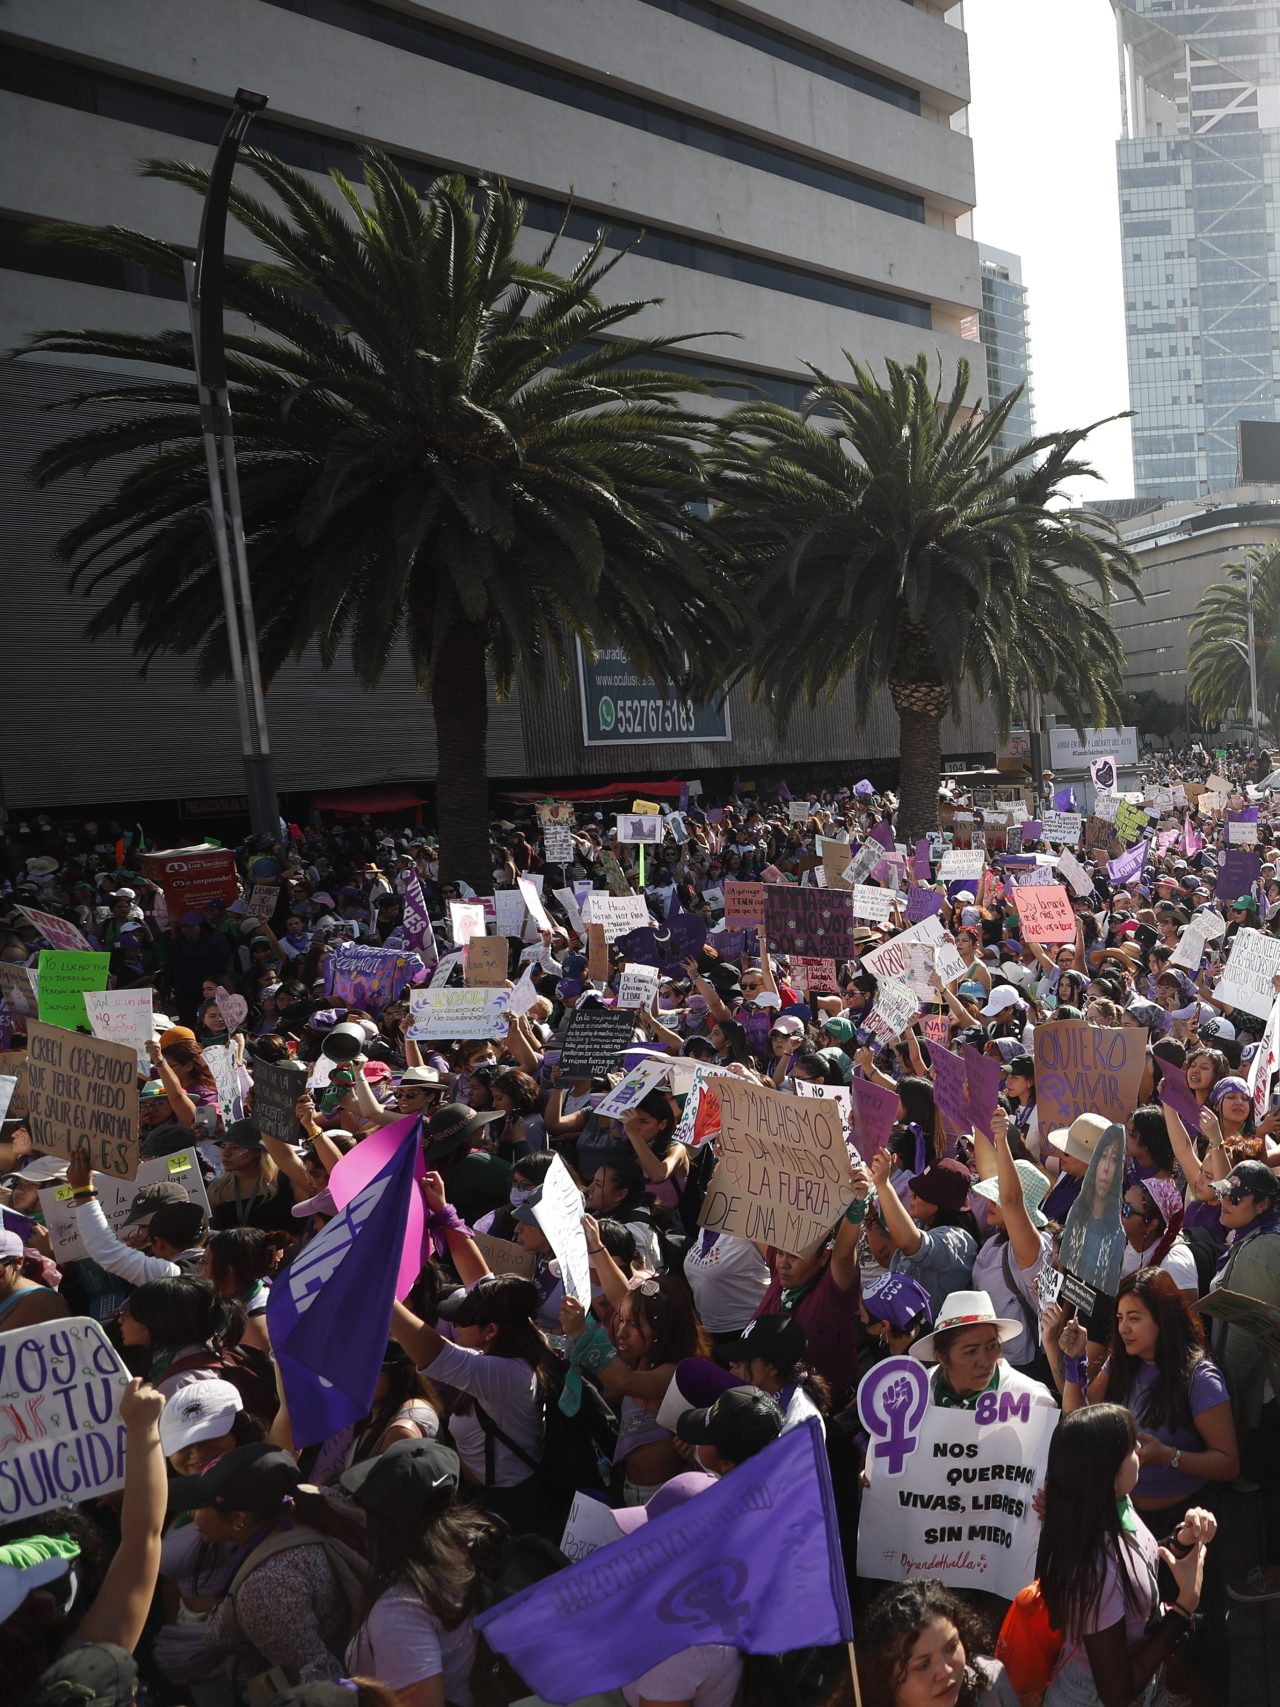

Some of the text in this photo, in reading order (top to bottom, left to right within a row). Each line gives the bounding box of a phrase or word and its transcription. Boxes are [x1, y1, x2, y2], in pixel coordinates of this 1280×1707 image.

[1057, 740, 1069, 748] ANDA
[948, 763, 963, 772] 104
[732, 897, 754, 905] TIENEN
[1016, 888, 1037, 913] Soy
[616, 912, 628, 920] HOY
[821, 914, 852, 936] VOY
[61, 962, 91, 971] LUCHO
[622, 992, 641, 1001] LIBRE
[96, 1012, 110, 1025] NO
[576, 1013, 583, 1021] En
[31, 1035, 133, 1085] CRECÍ CREYENDO
[1039, 1028, 1127, 1071] QUIERO
[591, 1065, 609, 1074] HOY
[29, 1064, 126, 1110] QUE TENER MIEDO
[812, 1086, 824, 1098] NO
[1063, 1072, 1125, 1111] VIVIR
[30, 1091, 136, 1143] DE SALIR ES NORMAL
[719, 1084, 741, 1122] AL
[740, 1089, 833, 1150] MACHISMO
[33, 1117, 54, 1147] NO
[101, 1139, 129, 1174] ES
[721, 1127, 841, 1184] LE DA MIEDO
[116, 1187, 126, 1206] la
[747, 1162, 831, 1219] LA FUERZA
[704, 1191, 743, 1232] DE
[745, 1202, 777, 1244] UNA
[53, 1377, 114, 1431] TU
[975, 1390, 1031, 1426] 8M
[933, 1442, 979, 1458] NOS
[899, 1491, 1024, 1518] VIVAS, LIBRES
[924, 1525, 1012, 1549] SIN MIEDO
